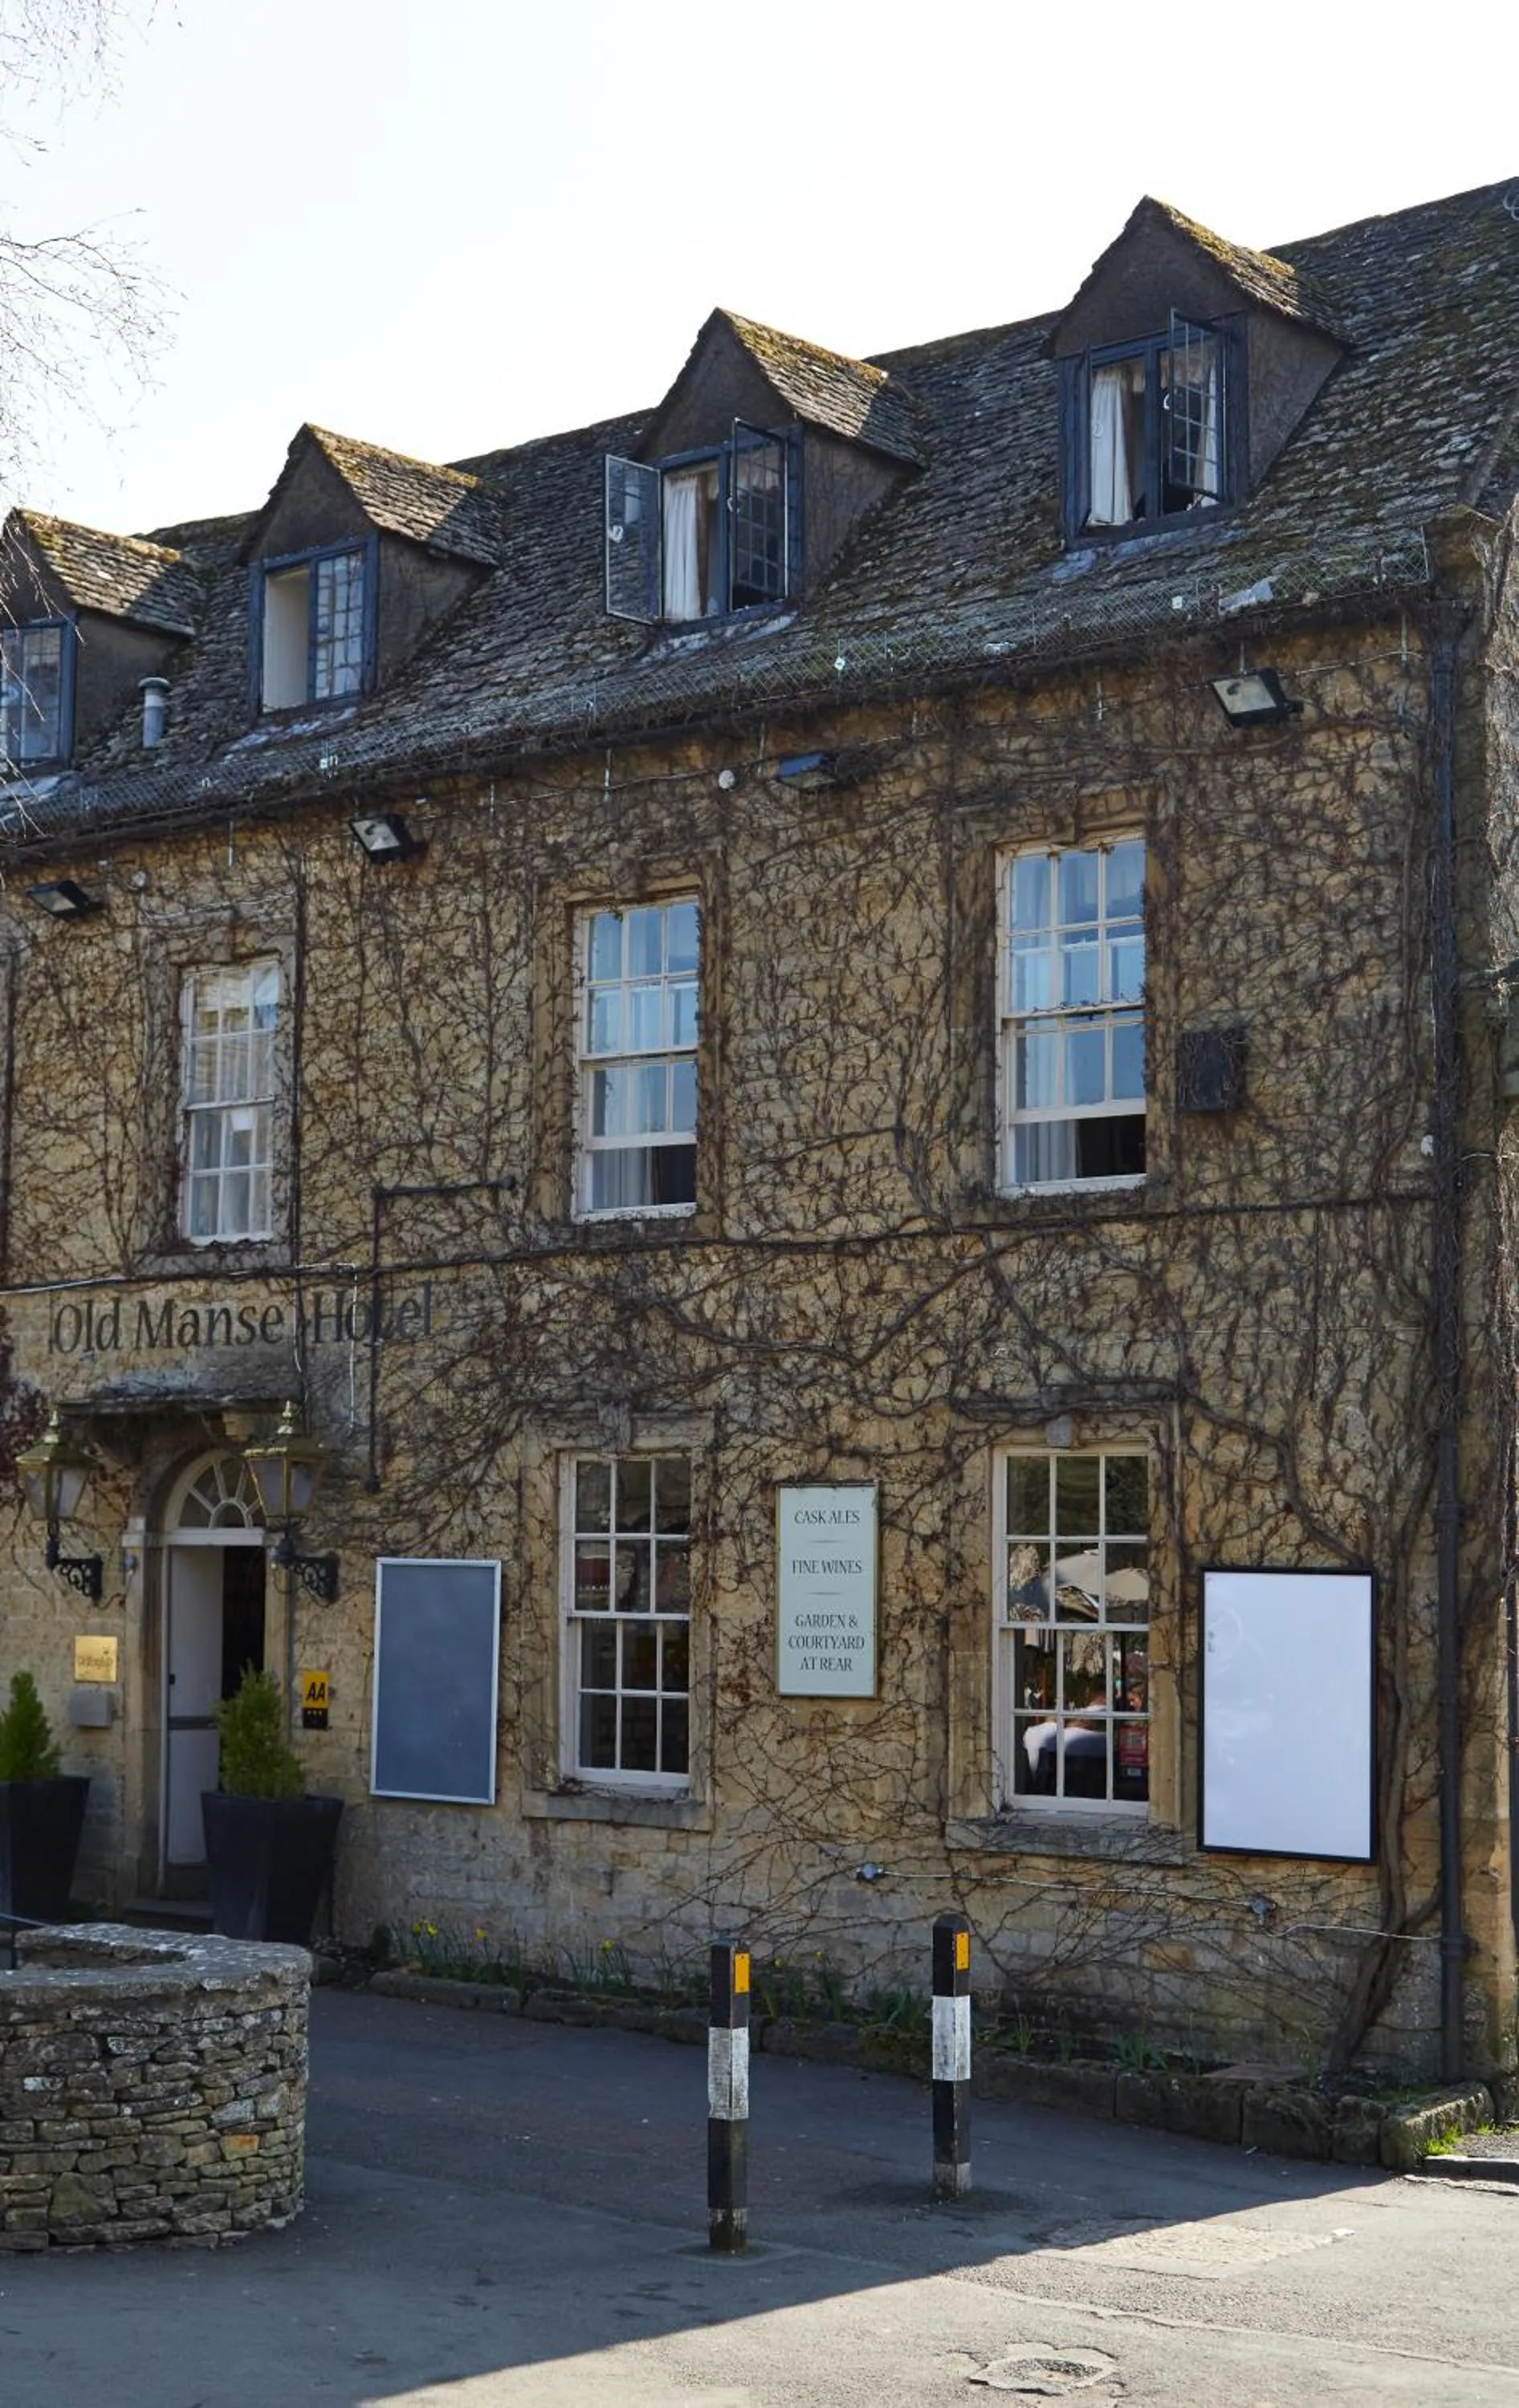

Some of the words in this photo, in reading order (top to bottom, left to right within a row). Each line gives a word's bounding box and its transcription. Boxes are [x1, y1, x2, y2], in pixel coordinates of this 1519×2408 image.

[54, 1297, 121, 1353] Old
[133, 1298, 283, 1350] Manse
[794, 1510, 826, 1524] CASK
[828, 1510, 860, 1524] ALES
[792, 1560, 820, 1574] FINE
[821, 1560, 862, 1574] WINES
[795, 1614, 845, 1628] GARDEN
[848, 1615, 858, 1629] &
[788, 1635, 865, 1649] COURTYARD
[799, 1656, 817, 1670] AT
[819, 1657, 853, 1671] REAR
[305, 1682, 326, 1702] AA
